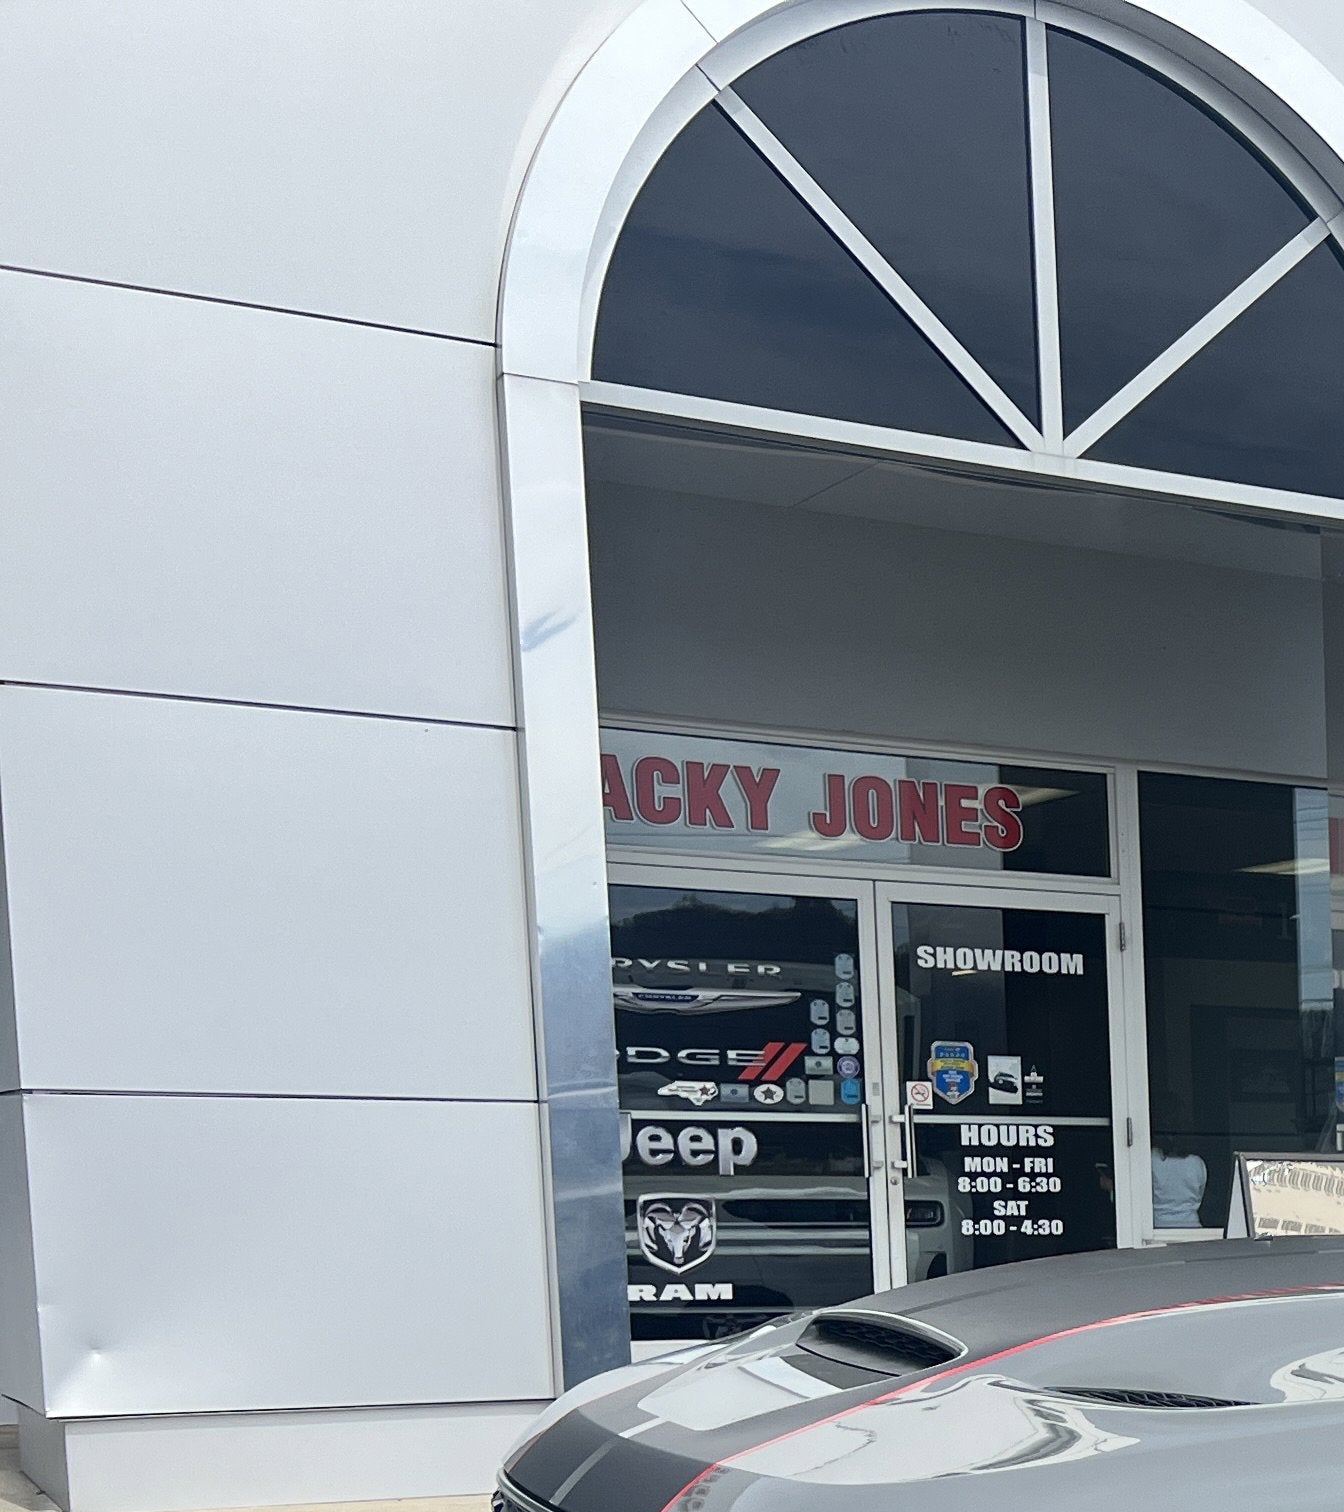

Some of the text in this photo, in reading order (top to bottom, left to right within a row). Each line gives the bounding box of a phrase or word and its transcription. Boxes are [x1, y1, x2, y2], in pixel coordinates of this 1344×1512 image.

[808, 774, 1024, 852] JONES
[916, 945, 1084, 977] SHOWROOM
[616, 1046, 768, 1066] DGE
[960, 1124, 1055, 1147] HOURS
[964, 1156, 1009, 1173] MON
[1024, 1157, 1054, 1174] FRI
[958, 1177, 1002, 1193] 8:00
[1018, 1177, 1062, 1193] 6:30
[993, 1200, 1029, 1216] SAT
[961, 1219, 1006, 1236] 8:00
[1020, 1219, 1064, 1236] 4:30
[627, 1283, 733, 1302] RAM
